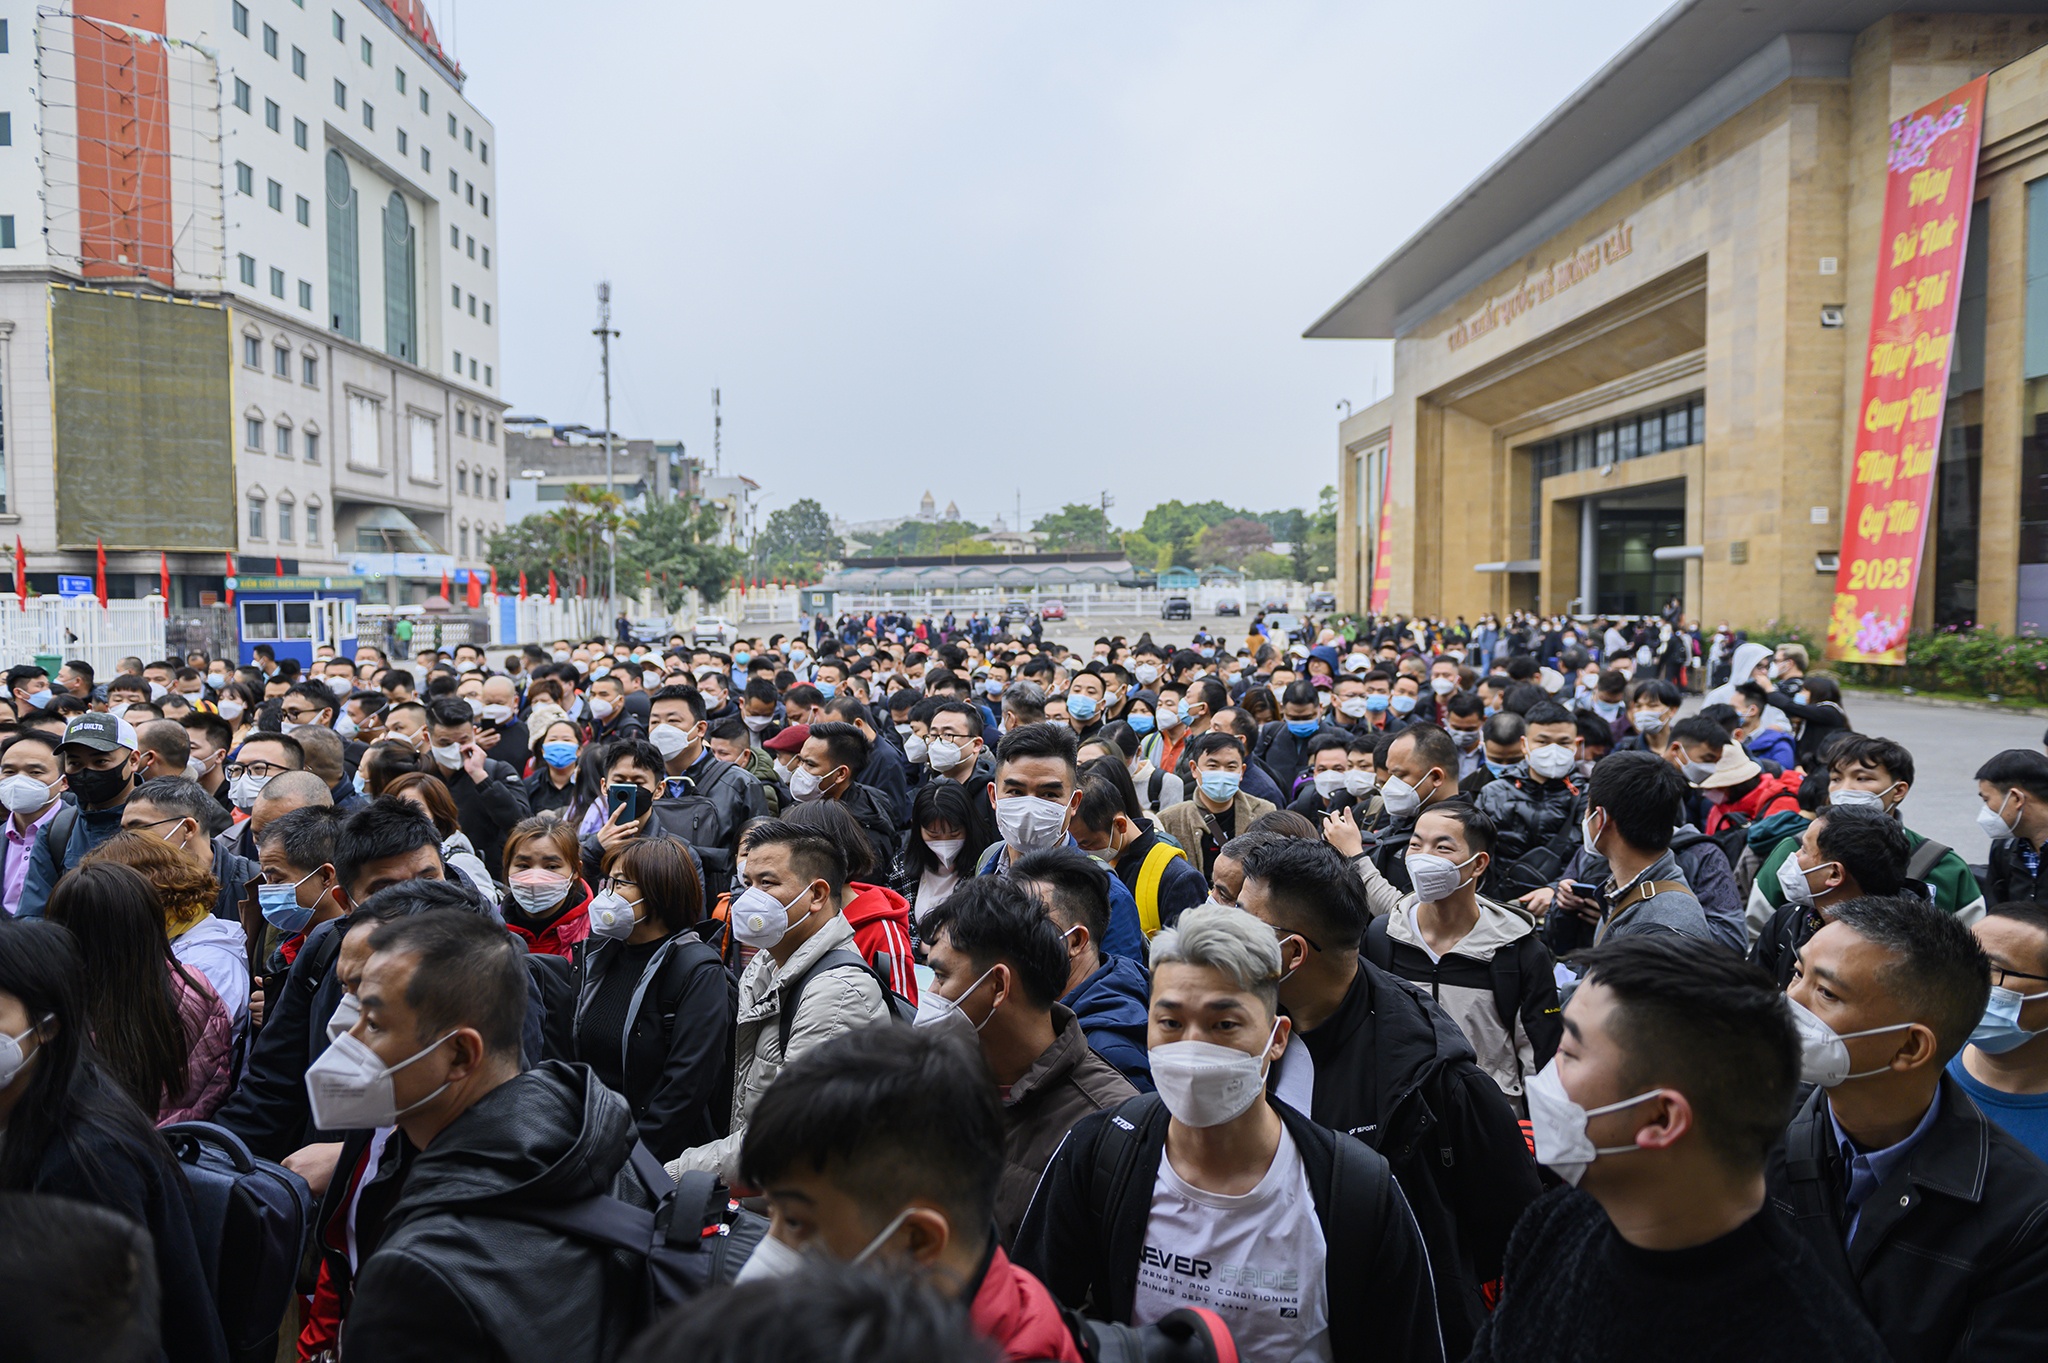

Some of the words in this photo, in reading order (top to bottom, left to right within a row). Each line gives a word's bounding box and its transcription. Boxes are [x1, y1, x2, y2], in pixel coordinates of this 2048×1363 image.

[1847, 557, 1912, 590] 2023
[1112, 1115, 1135, 1130] XTEP
[1136, 1279, 1175, 1296] RAINING
[1138, 1267, 1183, 1286] TRENGTH
[1188, 1282, 1211, 1293] AND
[1217, 1288, 1298, 1304] CONDITIONING
[1220, 1264, 1298, 1291] FADE
